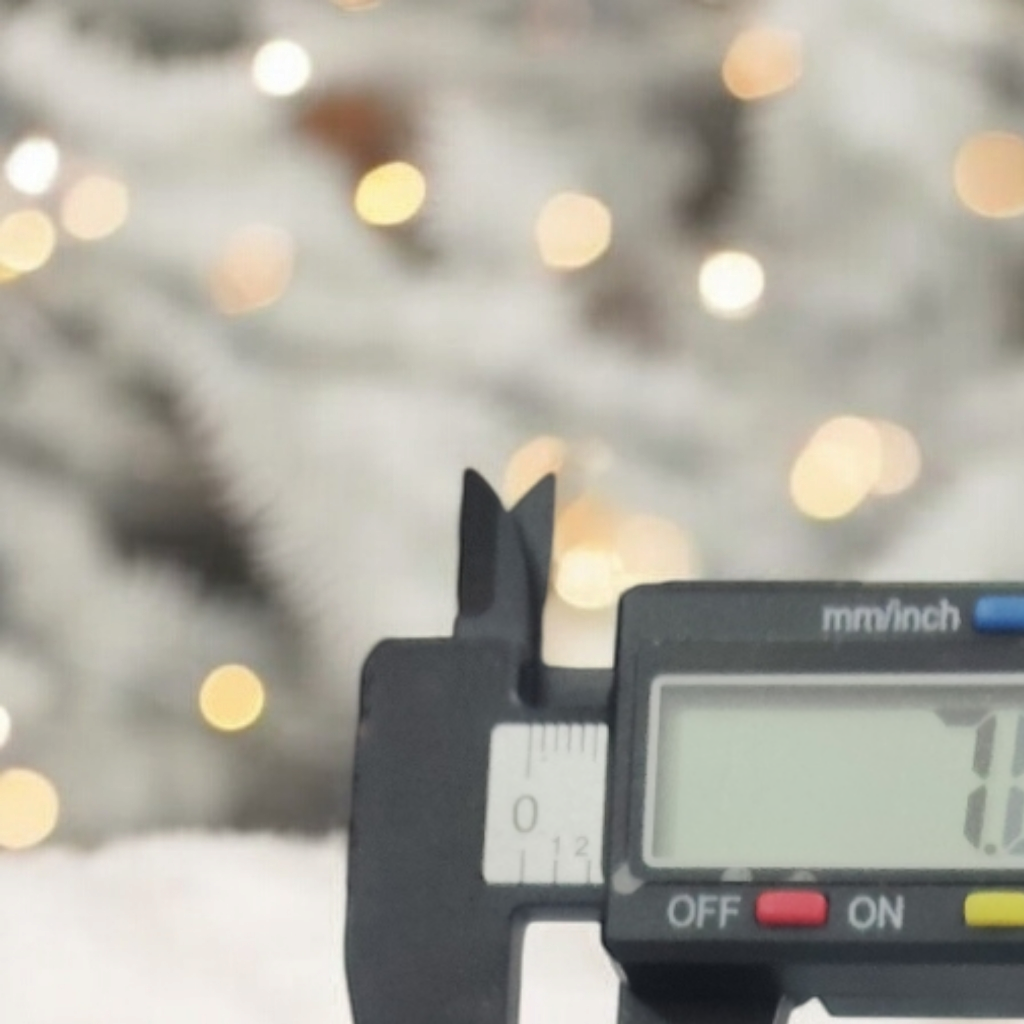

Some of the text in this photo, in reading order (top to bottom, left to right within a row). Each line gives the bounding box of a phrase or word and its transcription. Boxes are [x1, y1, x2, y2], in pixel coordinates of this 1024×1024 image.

[822, 600, 960, 633] mm/inch
[512, 794, 539, 833] 0
[667, 896, 742, 930] OFF
[847, 895, 905, 930] ON
